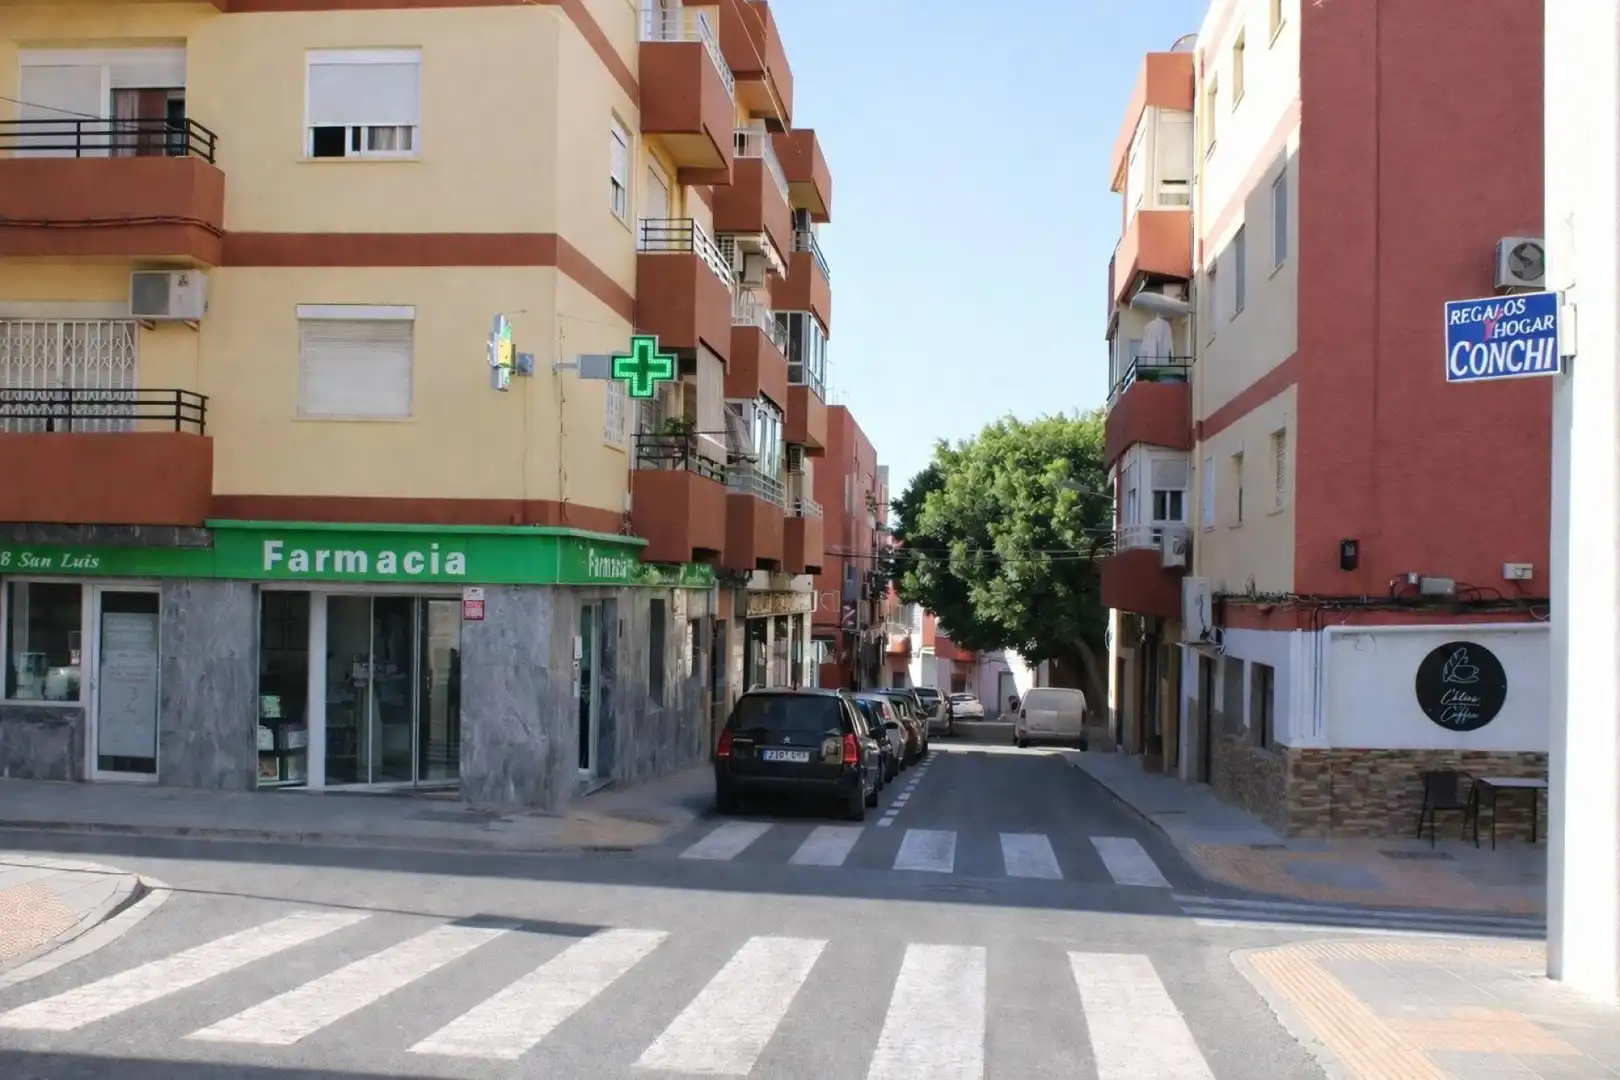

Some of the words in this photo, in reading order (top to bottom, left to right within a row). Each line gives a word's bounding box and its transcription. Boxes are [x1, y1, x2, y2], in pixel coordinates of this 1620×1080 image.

[1450, 299, 1526, 326] REGALOS
[1493, 315, 1554, 339] HOGAR
[1450, 337, 1555, 377] CONCHI
[17, 552, 52, 569] San
[60, 552, 100, 569] Luis
[263, 540, 466, 575] Farmacia
